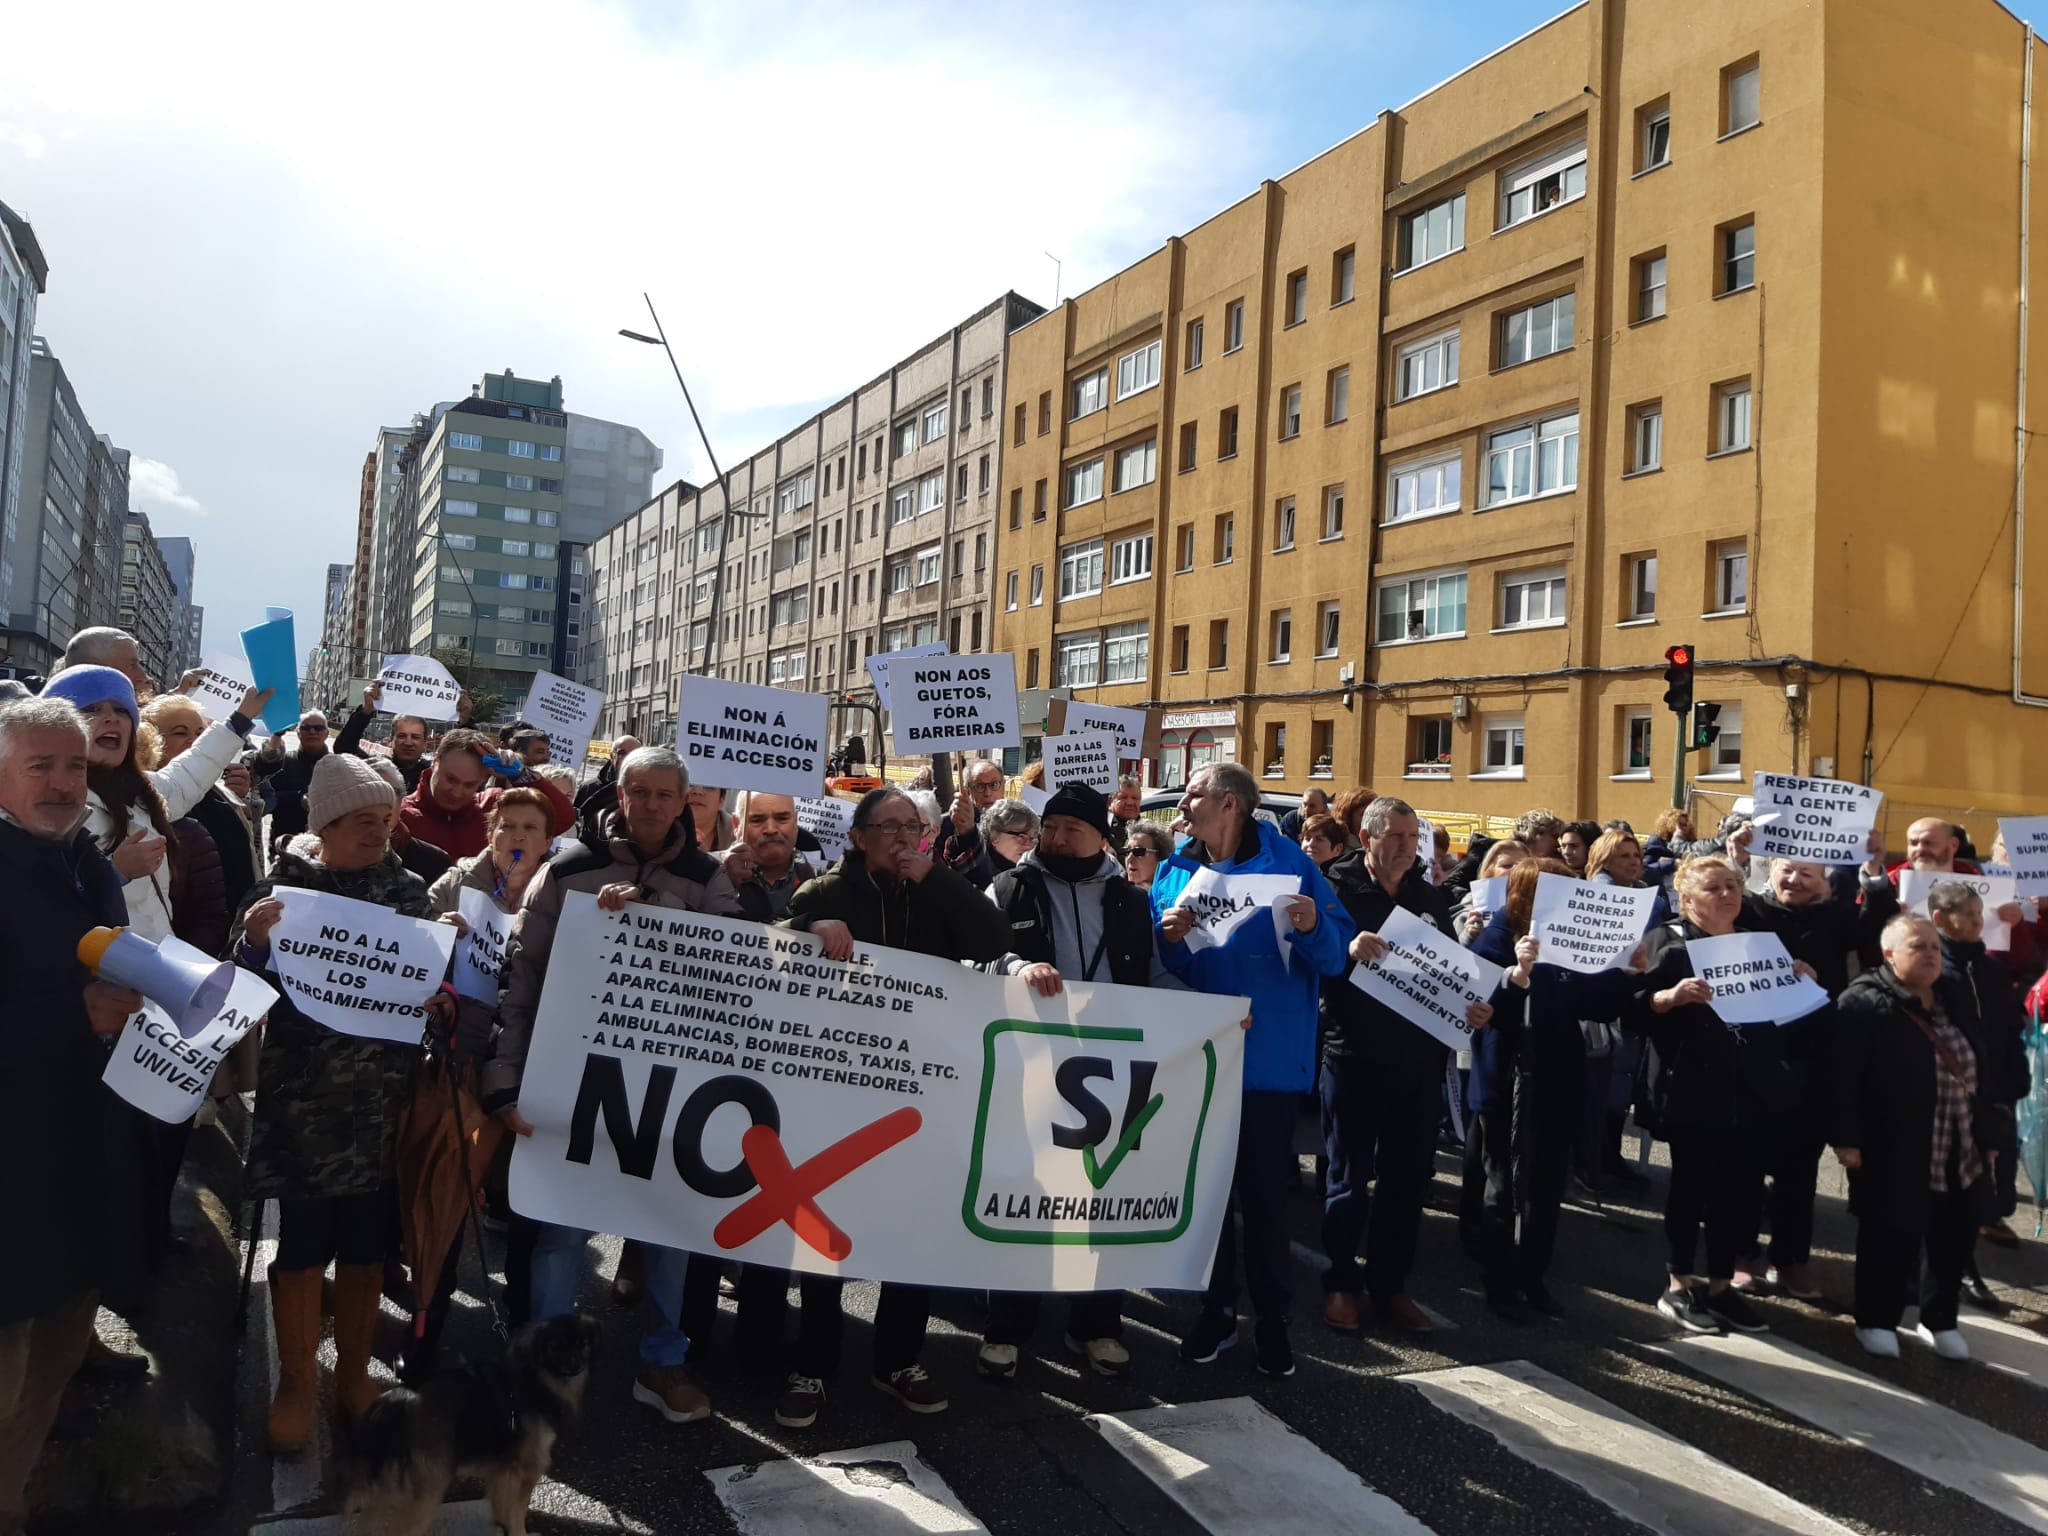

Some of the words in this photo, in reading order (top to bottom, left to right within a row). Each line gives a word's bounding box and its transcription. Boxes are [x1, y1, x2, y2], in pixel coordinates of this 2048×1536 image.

[382, 670, 440, 688] REFORMA
[915, 670, 950, 683] NON
[957, 668, 990, 681] AOS
[379, 681, 412, 694] PERO
[415, 686, 433, 698] NO
[436, 688, 458, 701] ASÍ
[918, 686, 991, 702] GUETOS,
[552, 694, 580, 708] CONTRA
[724, 706, 767, 724] NON
[773, 710, 786, 727] Á
[934, 704, 978, 719] FÓRA
[909, 722, 1005, 740] BARREIRAS
[1084, 719, 1125, 733] FUERA
[557, 735, 573, 746] LAS
[688, 721, 818, 752] ELIMINACIÓN
[1057, 744, 1071, 752] NO
[1084, 741, 1102, 750] LAS
[689, 742, 716, 759] DE
[722, 747, 813, 772] ACCESOS
[1054, 753, 1106, 765] BARRERAS
[1054, 766, 1094, 777] CONTRA
[1097, 764, 1109, 773] LA
[1765, 776, 1854, 795] RESPETEN
[1858, 790, 1870, 798] A
[824, 802, 841, 811] LAS
[1773, 793, 1794, 806] LA
[1800, 798, 1856, 812] GENTE
[799, 816, 836, 828] CONTRA
[1795, 814, 1832, 826] CON
[1764, 825, 1858, 844] MOVILIDAD
[1764, 841, 1854, 860] REDUCIDA
[2016, 845, 2048, 854] SUPR
[1198, 892, 1235, 908] NON
[1244, 892, 1255, 906] Á
[1576, 887, 1595, 899] NO
[1598, 892, 1608, 901] A
[1612, 894, 1635, 905] LAS
[1568, 900, 1635, 917] BARRERAS
[1573, 914, 1624, 929] CONTRA
[320, 925, 349, 943] NO
[354, 934, 368, 948] A
[375, 938, 400, 955] LA
[486, 920, 504, 946] NO
[619, 913, 632, 926] A
[638, 916, 663, 932] UN
[669, 922, 724, 942] MURO
[730, 932, 769, 950] QUE
[775, 939, 813, 957] NOS
[1547, 923, 1636, 942] AMBULANCIAS,
[472, 932, 505, 965] MUR
[1551, 937, 1619, 953] BOMBEROS
[278, 938, 396, 975] SUPRESIÓN
[401, 964, 429, 981] DE
[614, 932, 627, 945] A
[634, 934, 668, 952] LAS
[674, 943, 774, 971] BARRERAS
[778, 960, 948, 1000] ARQUITECTÓNICAS.
[1387, 940, 1464, 994] SUPRESIÓN
[1416, 943, 1437, 960] NO
[1439, 959, 1449, 968] A
[1452, 966, 1469, 982] LA
[1572, 954, 1607, 965] TAXIS
[326, 969, 367, 989] LOS
[1703, 959, 1773, 980] REFORMA
[605, 972, 753, 1008] APARCAMIENTO
[610, 952, 623, 965] A
[630, 954, 653, 970] LA
[659, 960, 781, 992] ELIMINACIÓN
[787, 981, 811, 996] DE
[816, 985, 886, 1008] PLAZAS
[892, 998, 914, 1013] DE
[1412, 973, 1440, 996] LOS
[1750, 978, 1771, 992] NO
[1361, 960, 1472, 1035] APARCAMIENTOS
[601, 992, 614, 1005] A
[620, 994, 644, 1010] LA
[651, 999, 773, 1032] ELIMINACIÓN
[780, 1021, 813, 1038] DEL
[819, 1027, 892, 1049] ACCESO
[897, 1039, 909, 1053] A
[597, 1012, 740, 1049] AMBULANCIAS,
[746, 1036, 853, 1066] BOMBEROS,
[860, 1053, 916, 1076] TAXIS,
[922, 1063, 959, 1079] ETC.
[593, 1031, 606, 1045] A
[612, 1034, 635, 1050] LA
[642, 1039, 735, 1066] RETIRADA
[741, 1056, 766, 1072] DE
[772, 1061, 924, 1095] CONTENEDORES.
[1051, 1056, 1158, 1150] SI
[565, 1052, 780, 1198] NO
[984, 1193, 999, 1217] A
[1005, 1194, 1030, 1219] LA
[1037, 1192, 1179, 1221] REHABILITACIÓN
